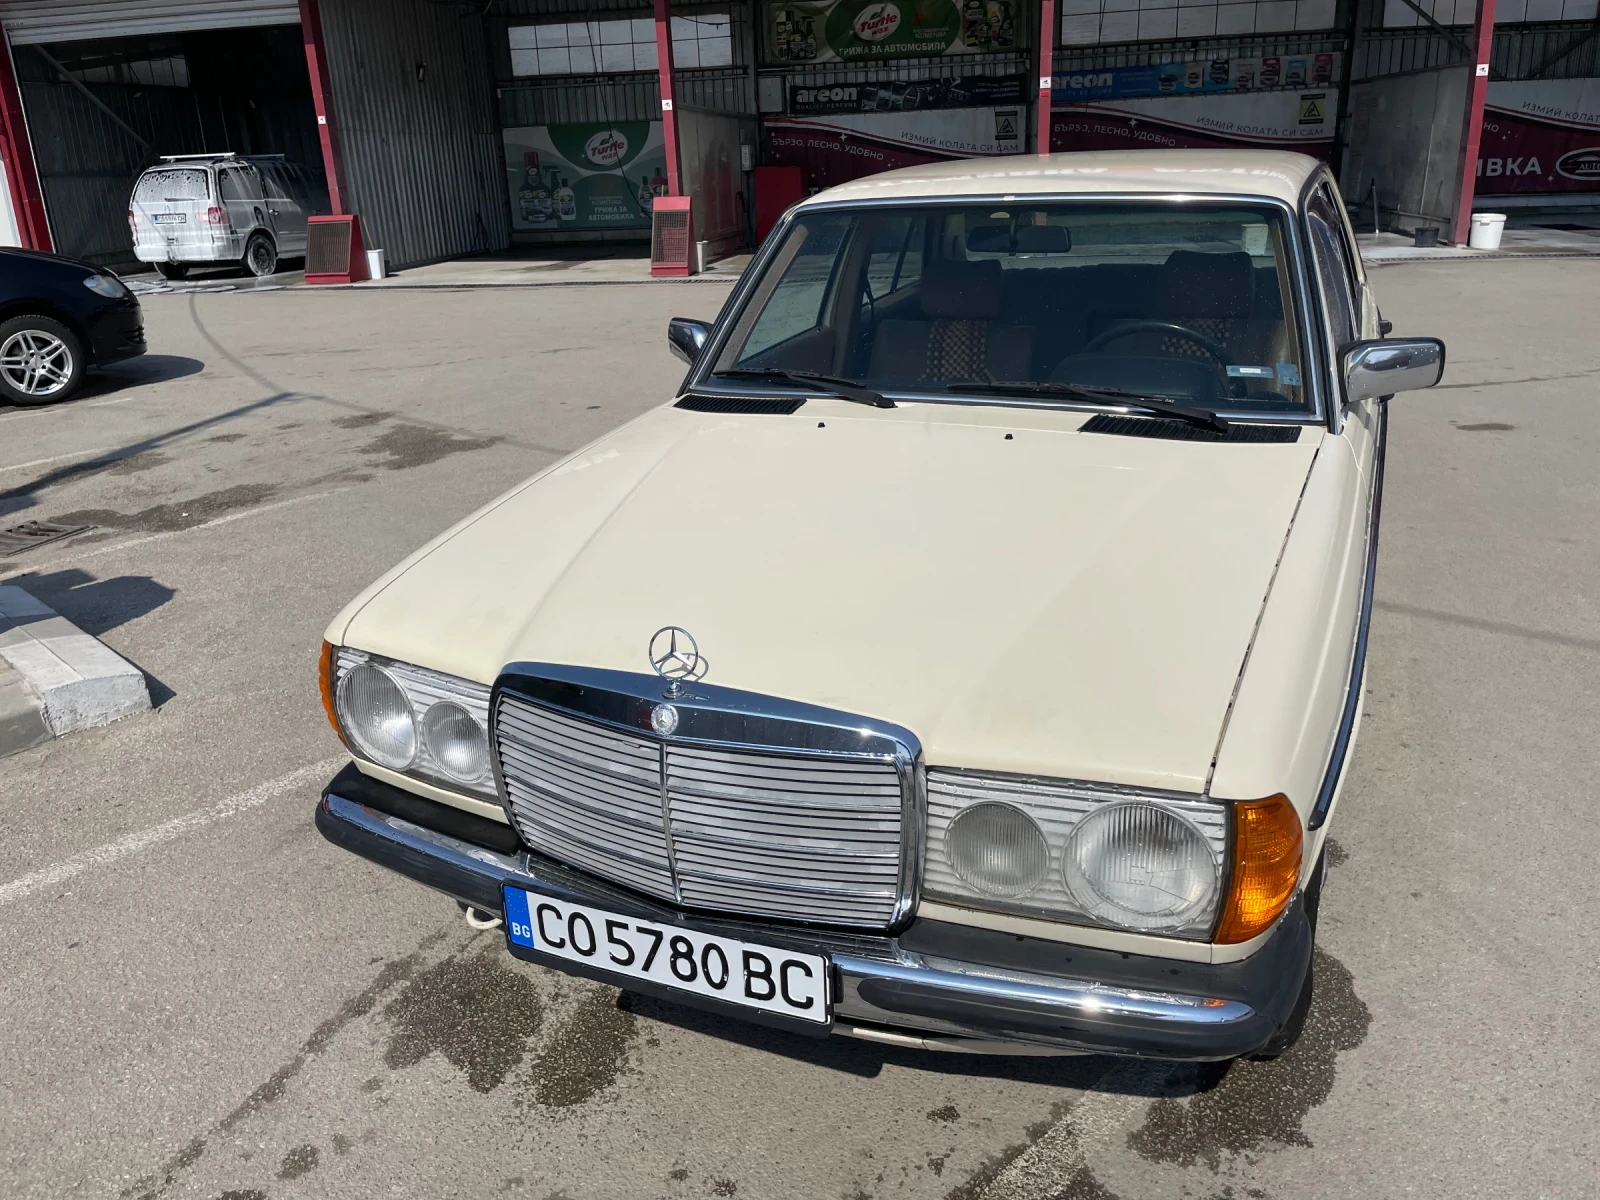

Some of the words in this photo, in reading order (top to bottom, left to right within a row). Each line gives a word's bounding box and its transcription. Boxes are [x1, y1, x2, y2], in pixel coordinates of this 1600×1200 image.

[860, 13, 897, 32] Turtle
[871, 26, 889, 36] wax
[839, 46, 869, 56] ГРИЖА
[871, 45, 882, 54] ЗА
[884, 42, 947, 52] АВТОМОБИЛА
[796, 88, 857, 103] areon
[1522, 101, 1562, 117] ИЗМИЙ
[1054, 124, 1090, 133] БЪРЗО,
[1093, 125, 1130, 137] ЛЕСНО,
[1133, 130, 1176, 146] УДОБНО
[1196, 116, 1234, 131] ИЗМИЙ
[1236, 125, 1278, 136] КОЛАТА
[1300, 128, 1323, 137] САМ
[591, 141, 624, 156] Turtle
[772, 138, 805, 147] БЪРЗО,
[807, 140, 842, 151] ЛЕСНО,
[844, 144, 884, 161] УДОБНО
[901, 131, 936, 145] ИЗМИЙ
[939, 140, 977, 151] КОЛАТА
[996, 144, 1018, 152] САМ
[511, 921, 531, 938] BG
[536, 903, 597, 957] CO
[605, 919, 730, 991] 5780
[742, 949, 815, 1009] BC
